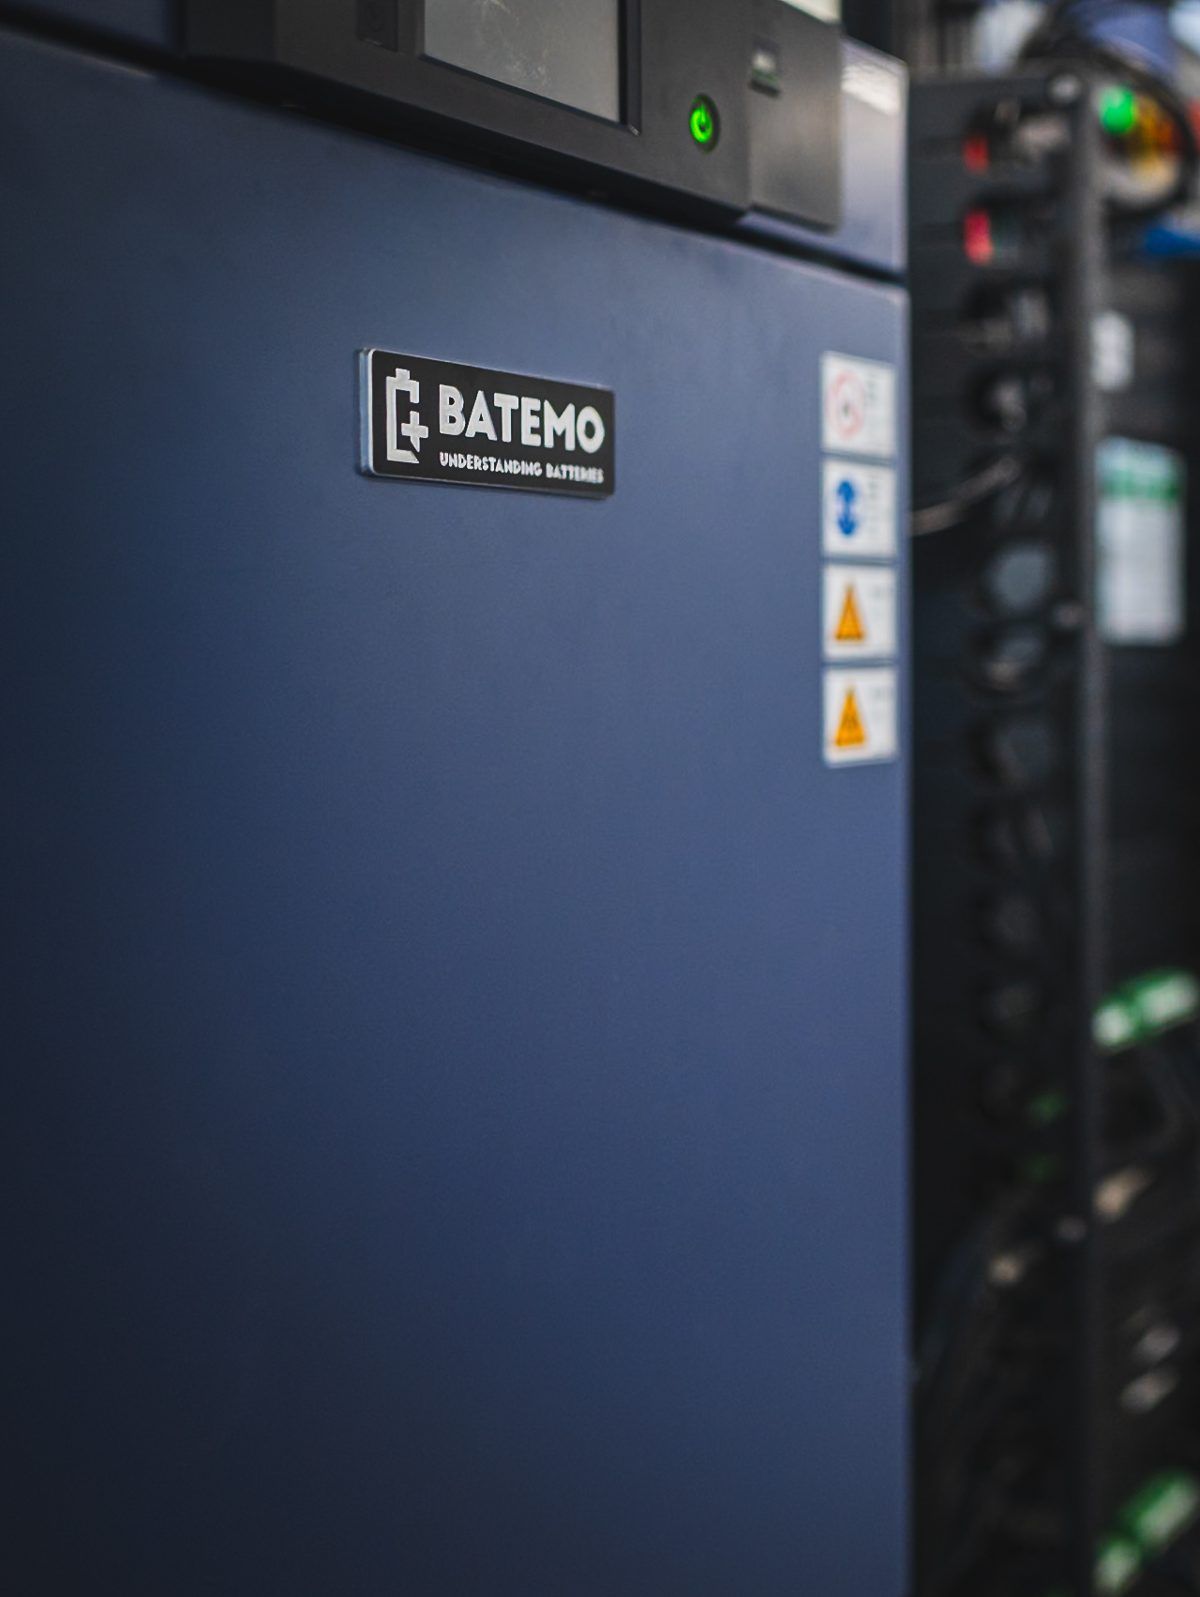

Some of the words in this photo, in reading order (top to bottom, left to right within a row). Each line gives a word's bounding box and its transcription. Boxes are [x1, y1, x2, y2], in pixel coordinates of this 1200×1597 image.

[439, 384, 605, 453] BATEMO
[439, 452, 542, 477] UNDERSTANDING
[546, 463, 604, 484] BATTERIES
